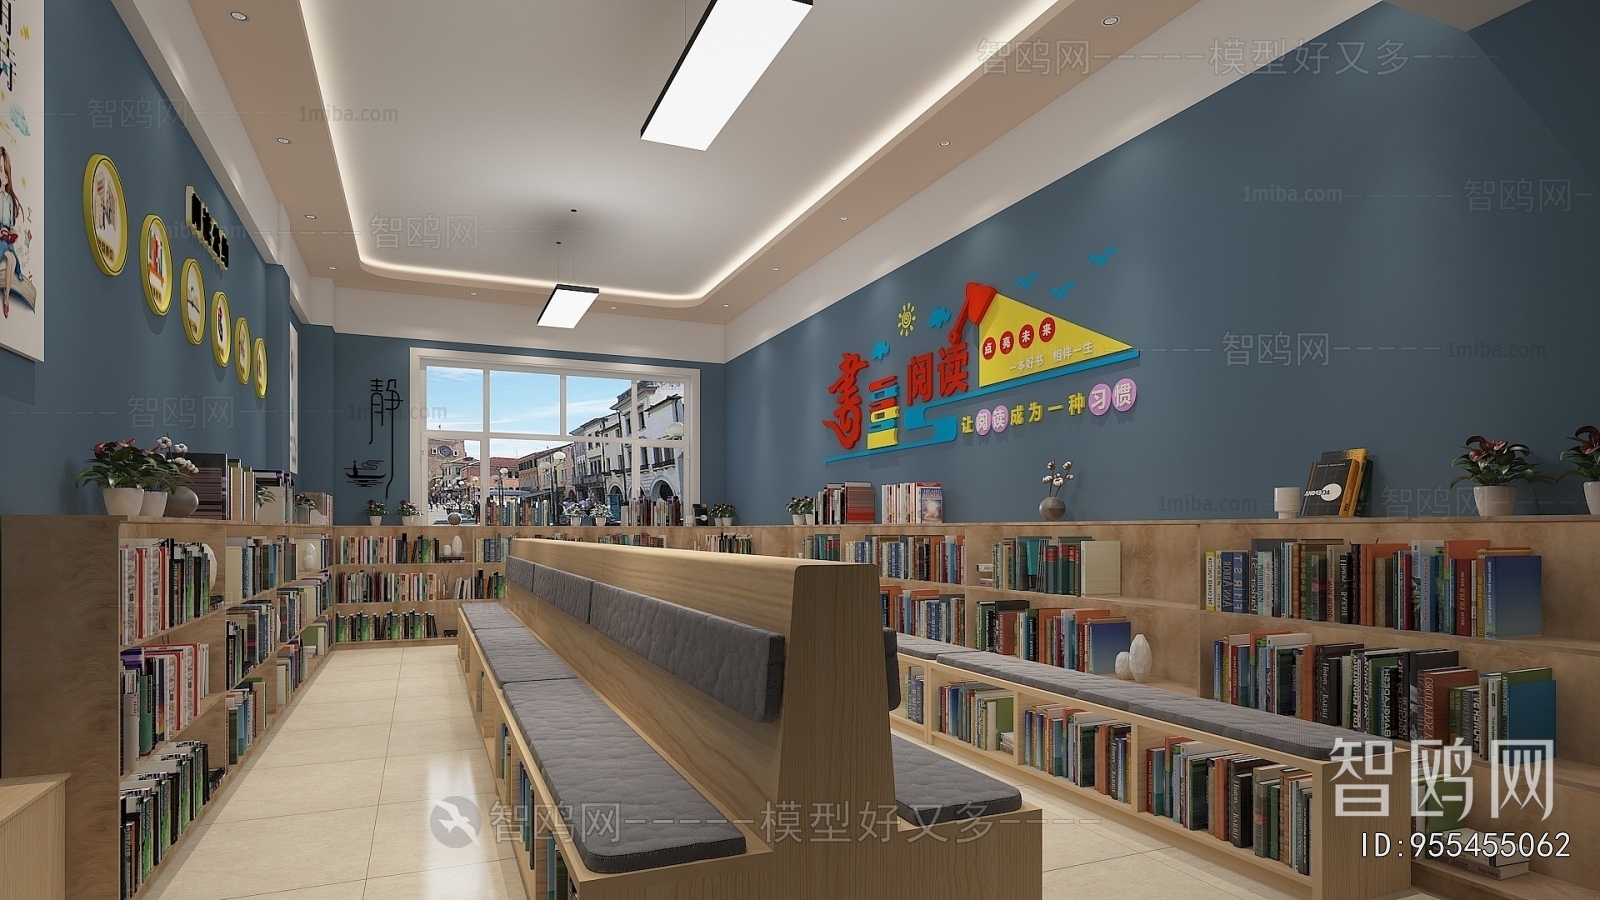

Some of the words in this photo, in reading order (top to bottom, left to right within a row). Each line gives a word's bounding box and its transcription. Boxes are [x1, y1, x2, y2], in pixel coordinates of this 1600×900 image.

[983, 320, 1055, 358] 点亮未来
[1009, 354, 1045, 372] 一本好书
[1052, 341, 1094, 362] 相伴一生
[906, 342, 970, 405] 阅读
[961, 380, 1135, 435] 让阅读成为一种习惯
